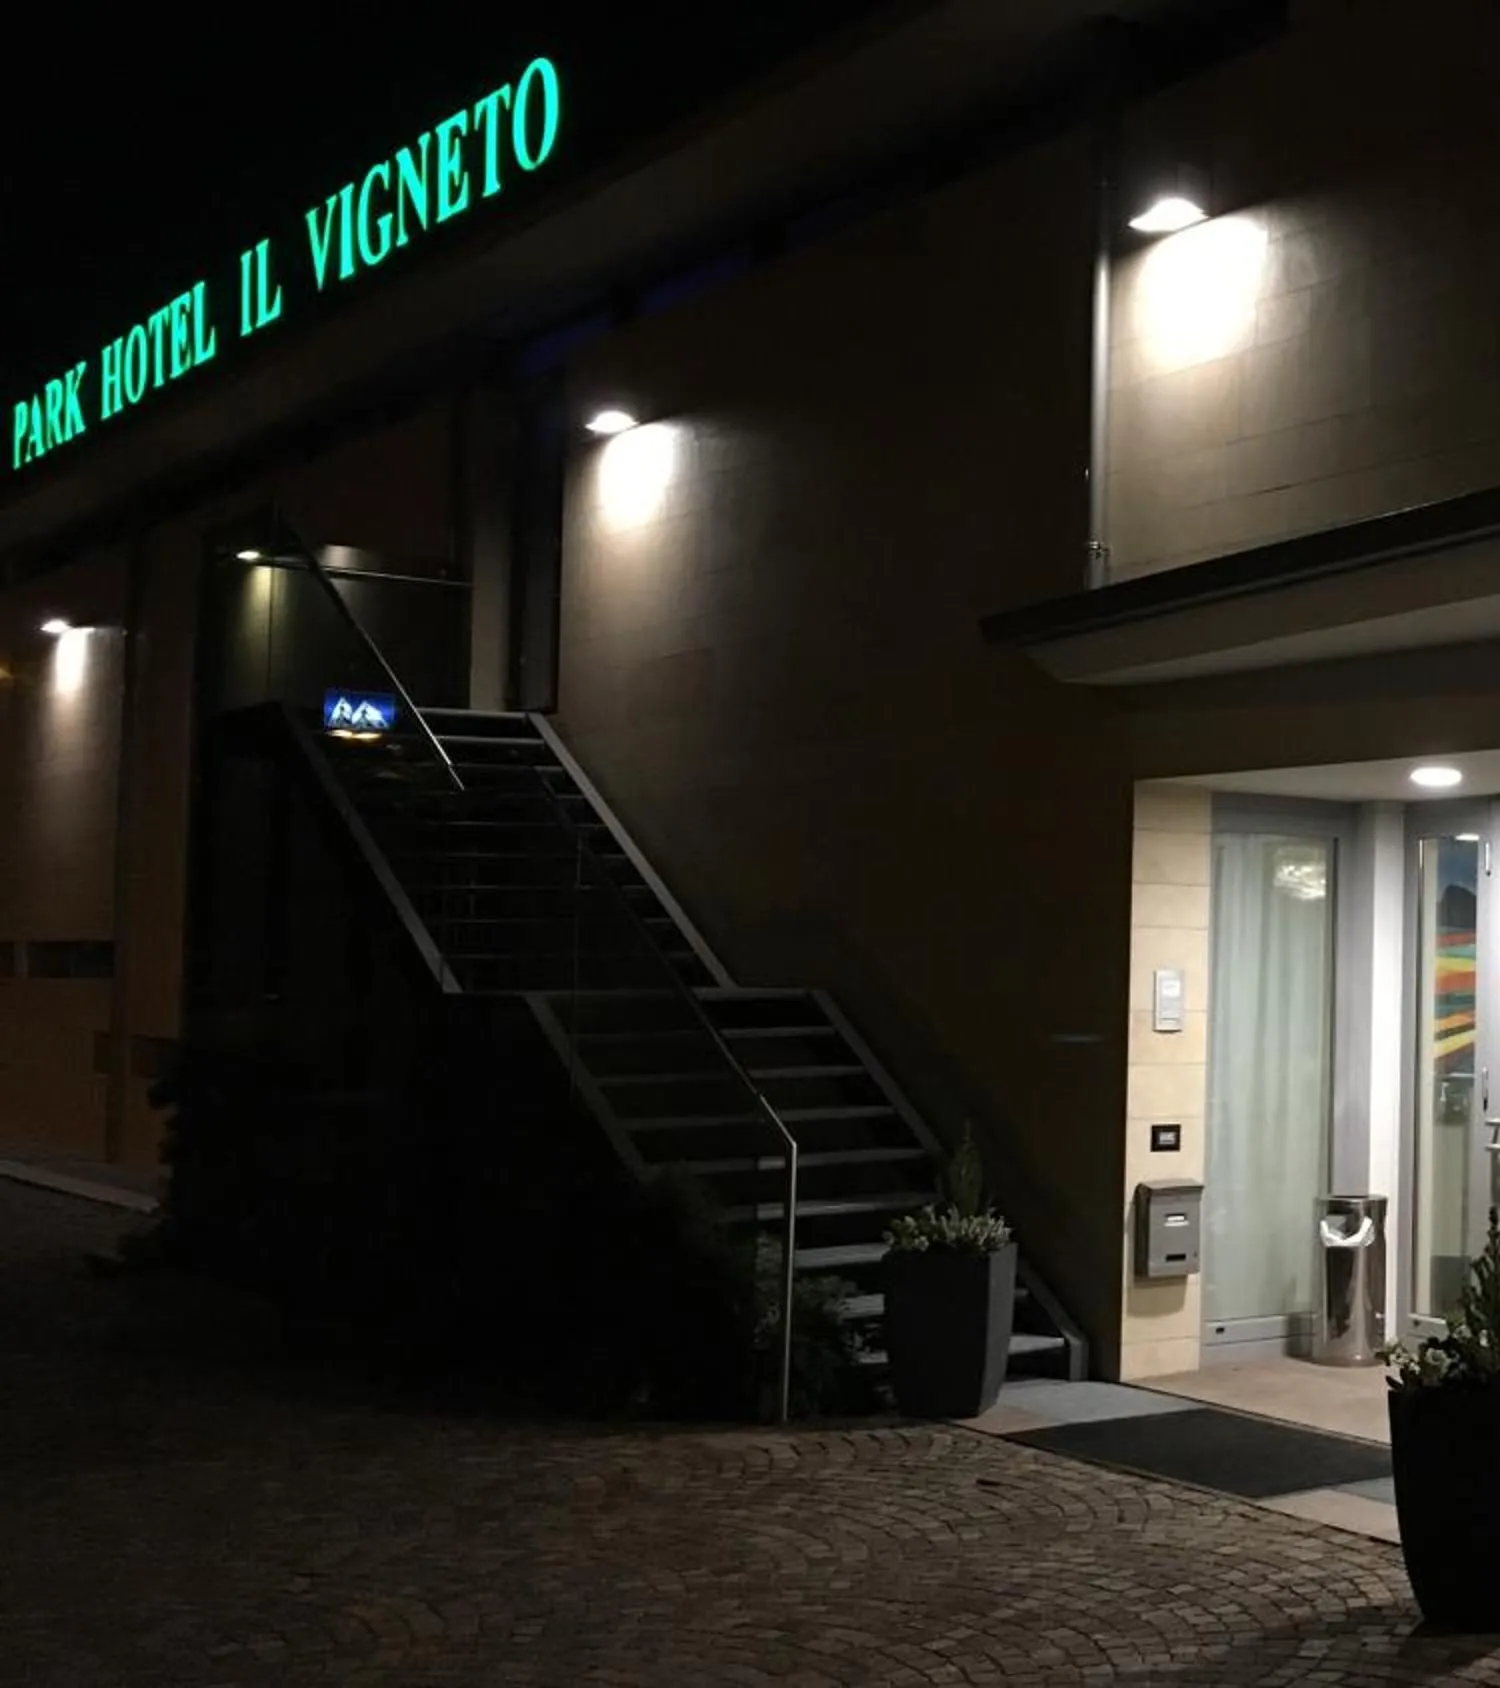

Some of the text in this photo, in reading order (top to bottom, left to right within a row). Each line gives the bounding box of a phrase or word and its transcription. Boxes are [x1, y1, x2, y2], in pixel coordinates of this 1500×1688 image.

[12, 56, 561, 470] PARK HOTEL IL VIGNETO
